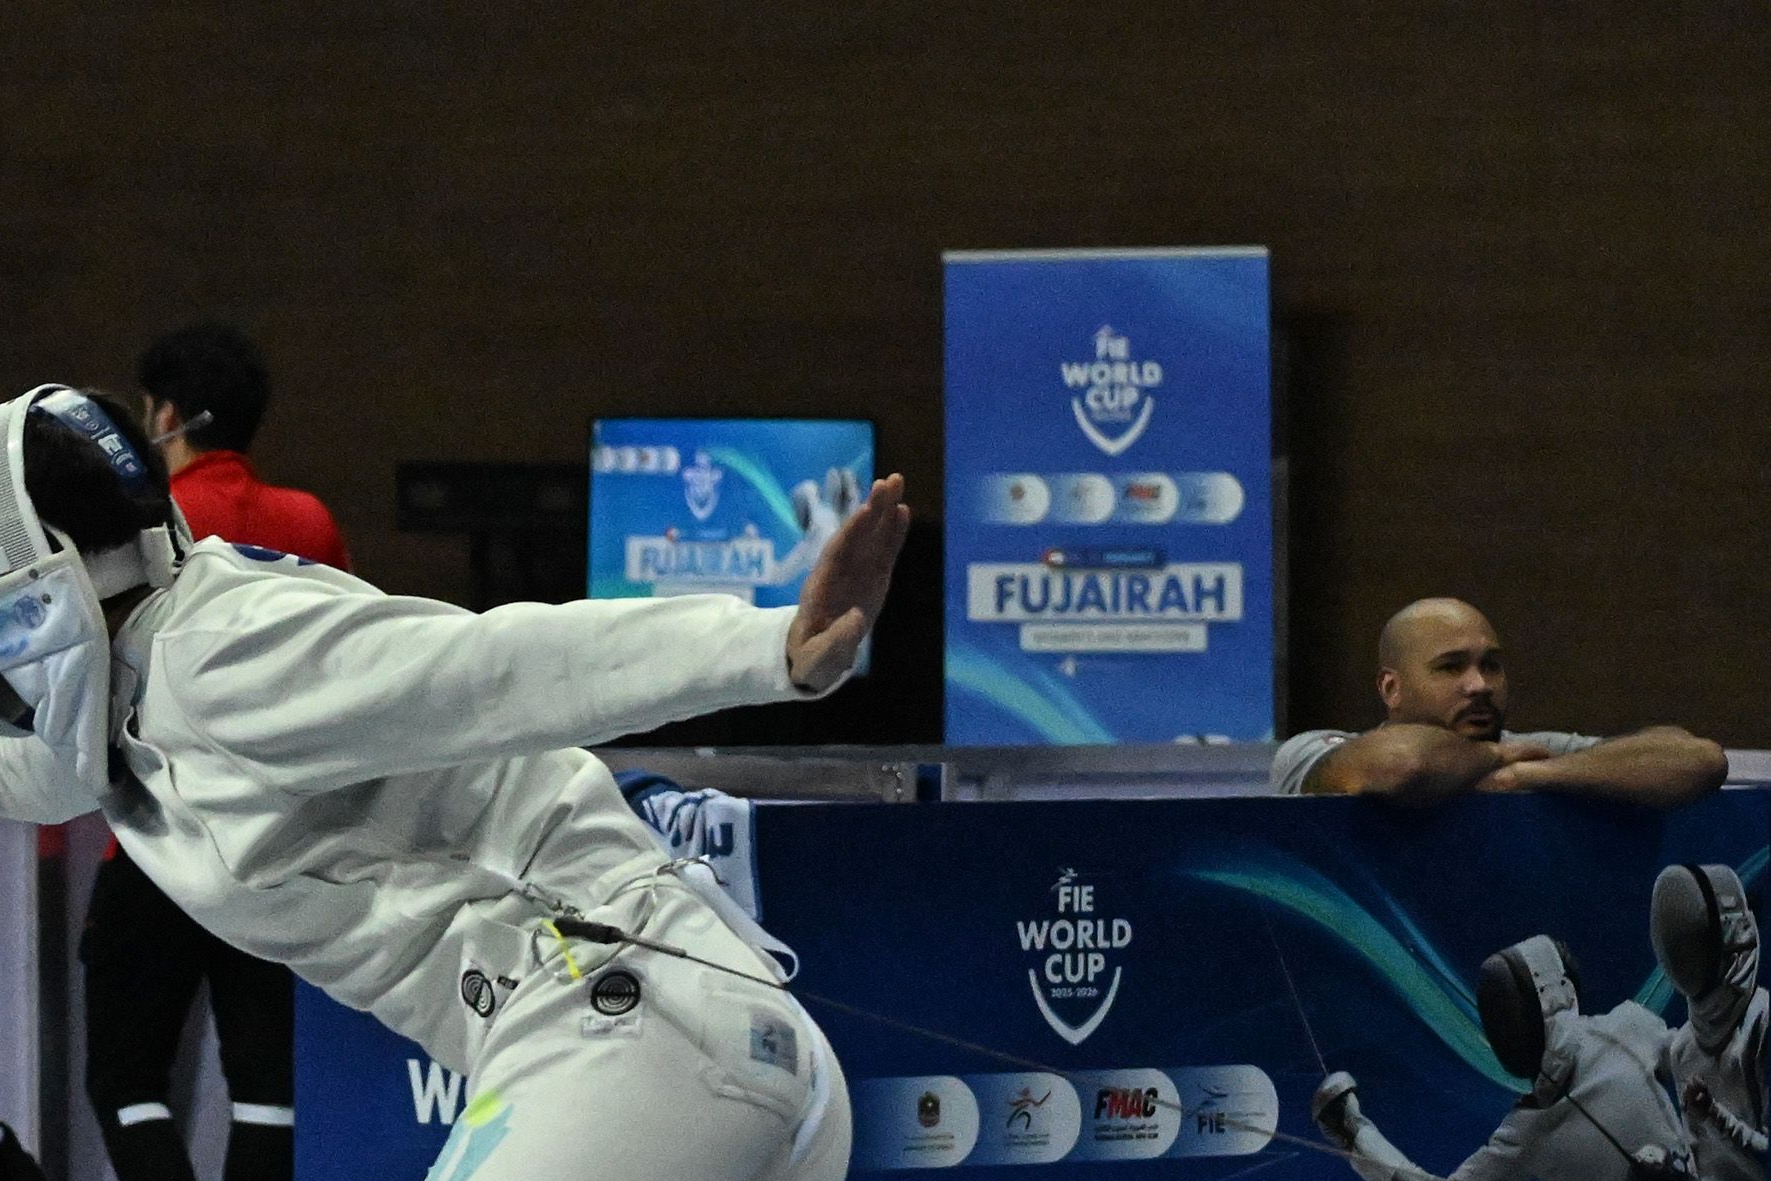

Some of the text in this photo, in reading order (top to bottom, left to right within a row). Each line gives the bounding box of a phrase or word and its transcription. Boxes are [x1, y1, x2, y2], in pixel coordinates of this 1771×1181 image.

[1060, 361, 1164, 388] WORLD
[1085, 386, 1141, 411] CUP
[994, 573, 1225, 613] FUJAIRAH
[1057, 884, 1095, 913] FIE
[1015, 918, 1133, 951] WORLD
[1044, 952, 1106, 984] CUP
[1093, 1086, 1159, 1120] FMAC
[1196, 1111, 1226, 1135] FIE
